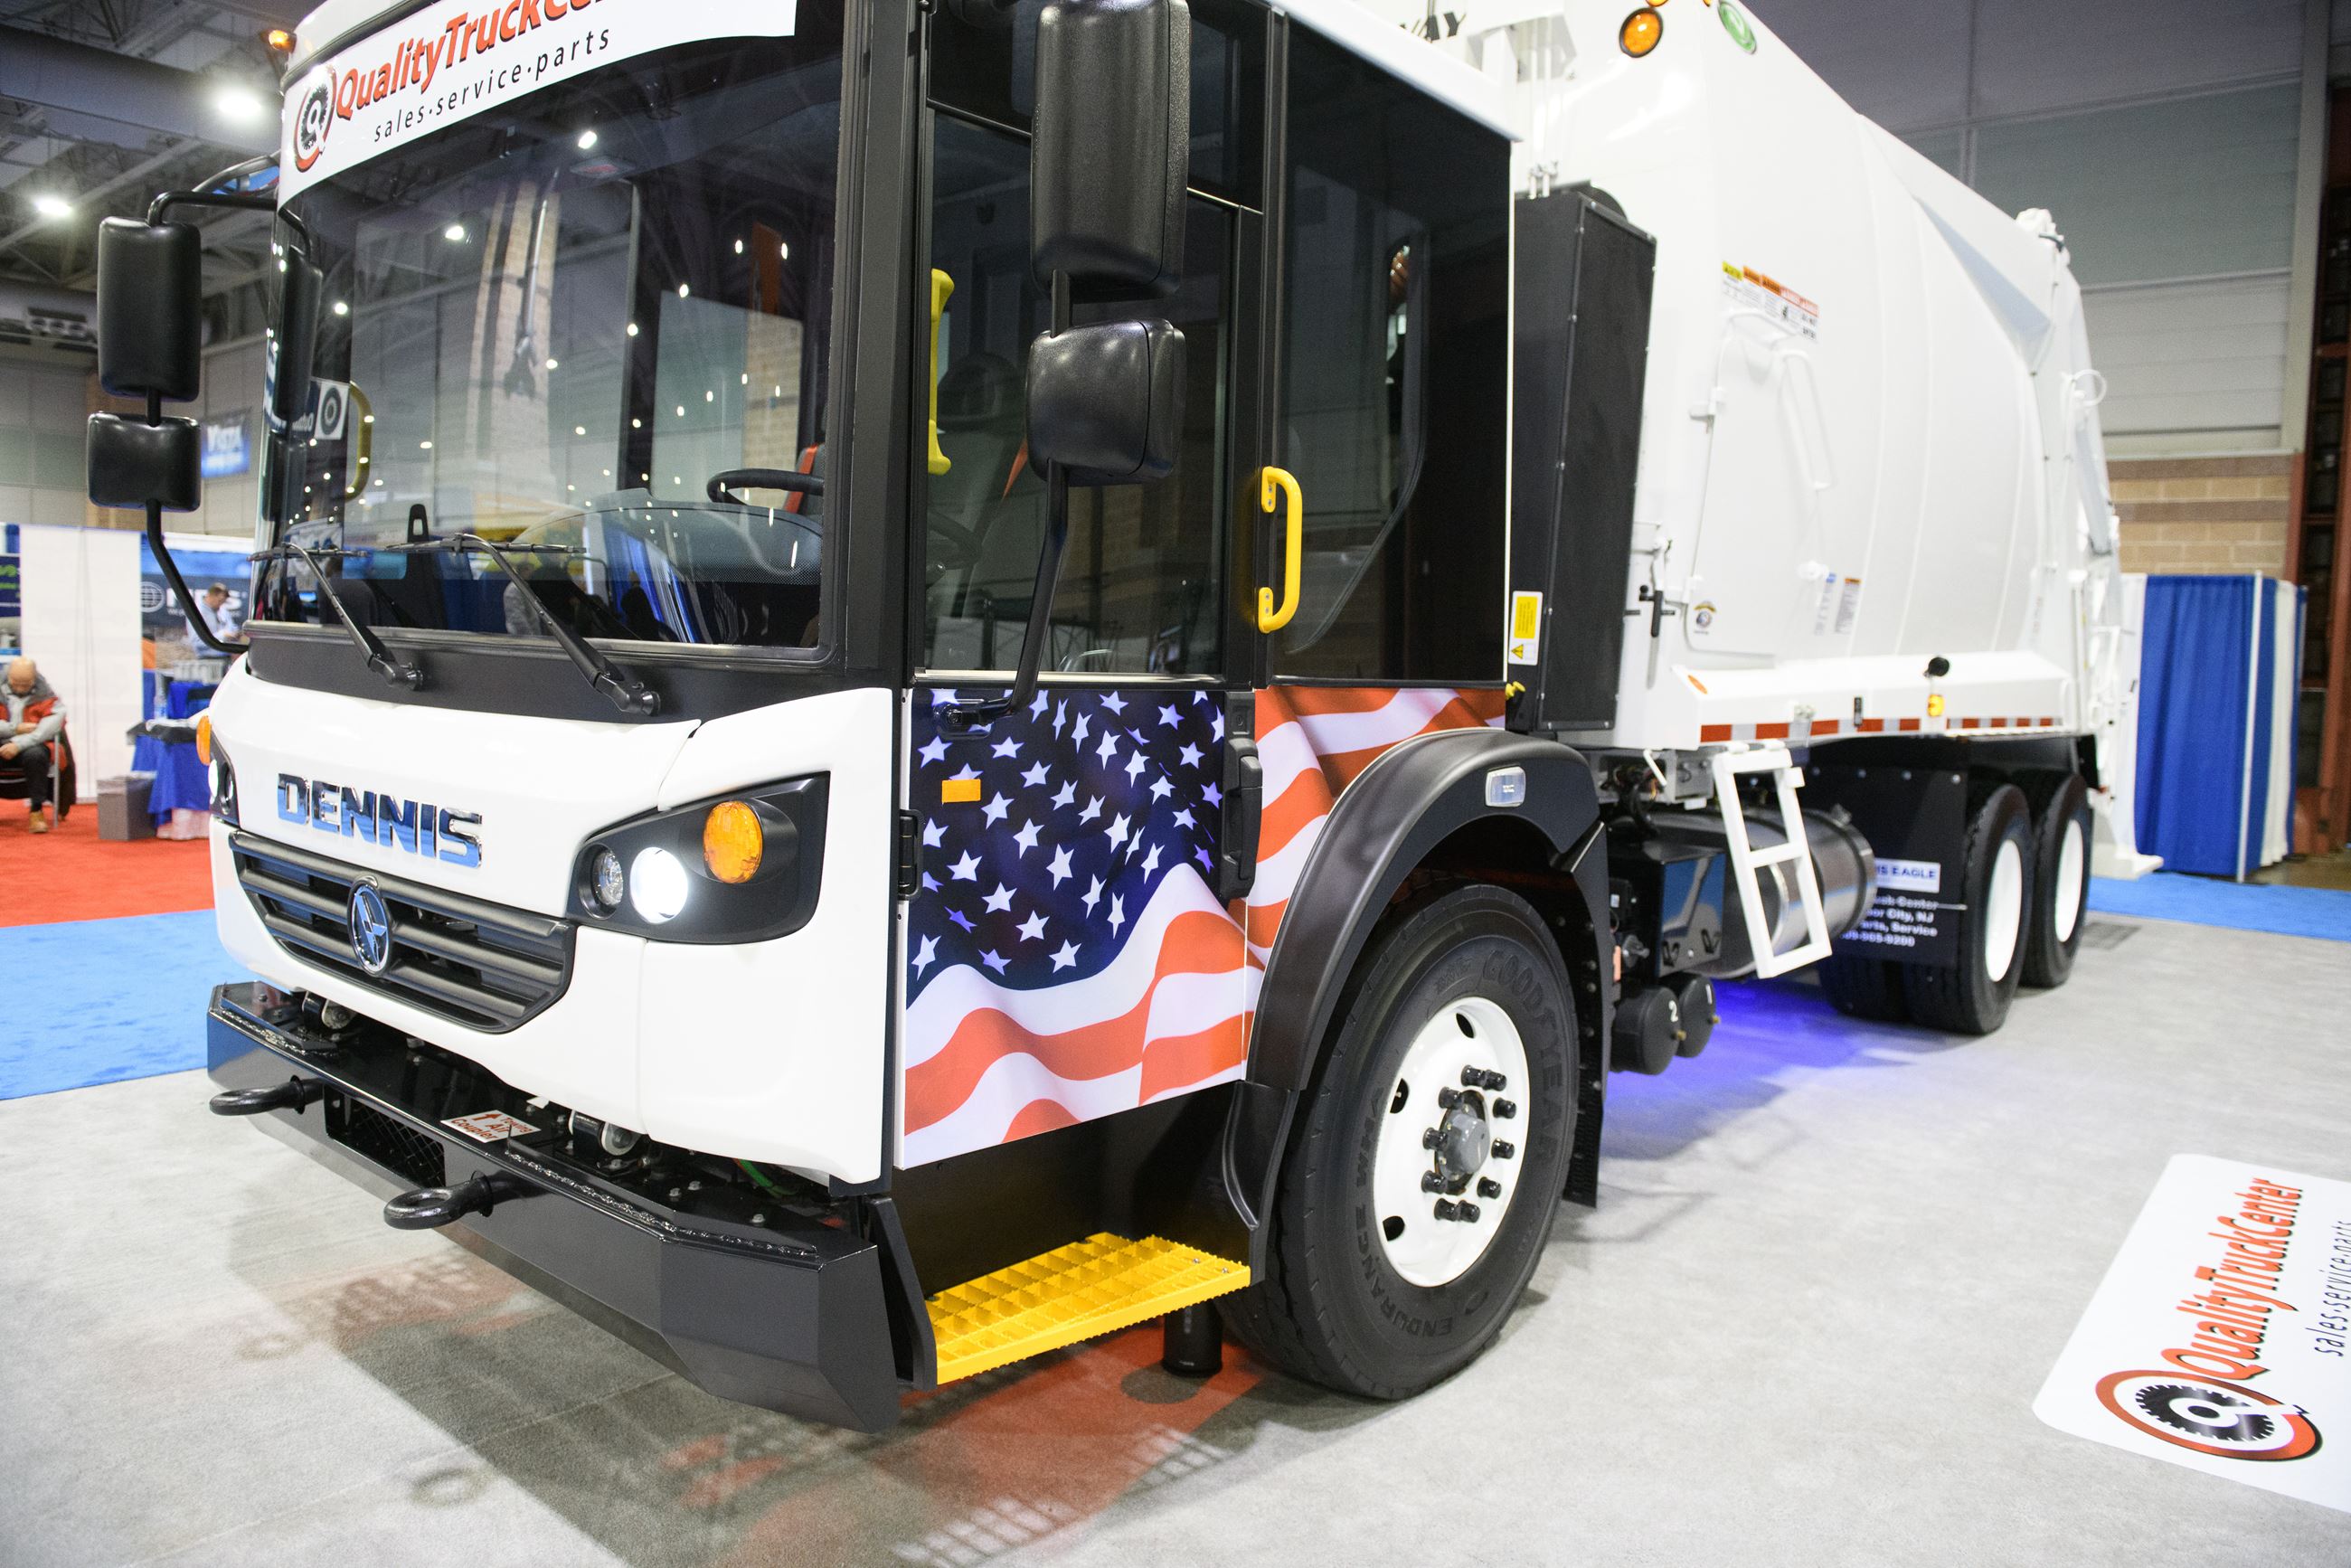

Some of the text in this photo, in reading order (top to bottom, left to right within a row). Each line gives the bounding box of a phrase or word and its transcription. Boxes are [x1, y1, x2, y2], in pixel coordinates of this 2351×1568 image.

[278, 773, 483, 869] DENNIS
[1893, 866, 1936, 879] EAGLE
[1896, 895, 1939, 911] Center
[1915, 911, 1934, 923] NJ
[1891, 921, 1938, 937] Service
[1668, 999, 1679, 1023] 2
[450, 1119, 499, 1139] Coupler
[2160, 1176, 2304, 1382] QualityTruckCenter
